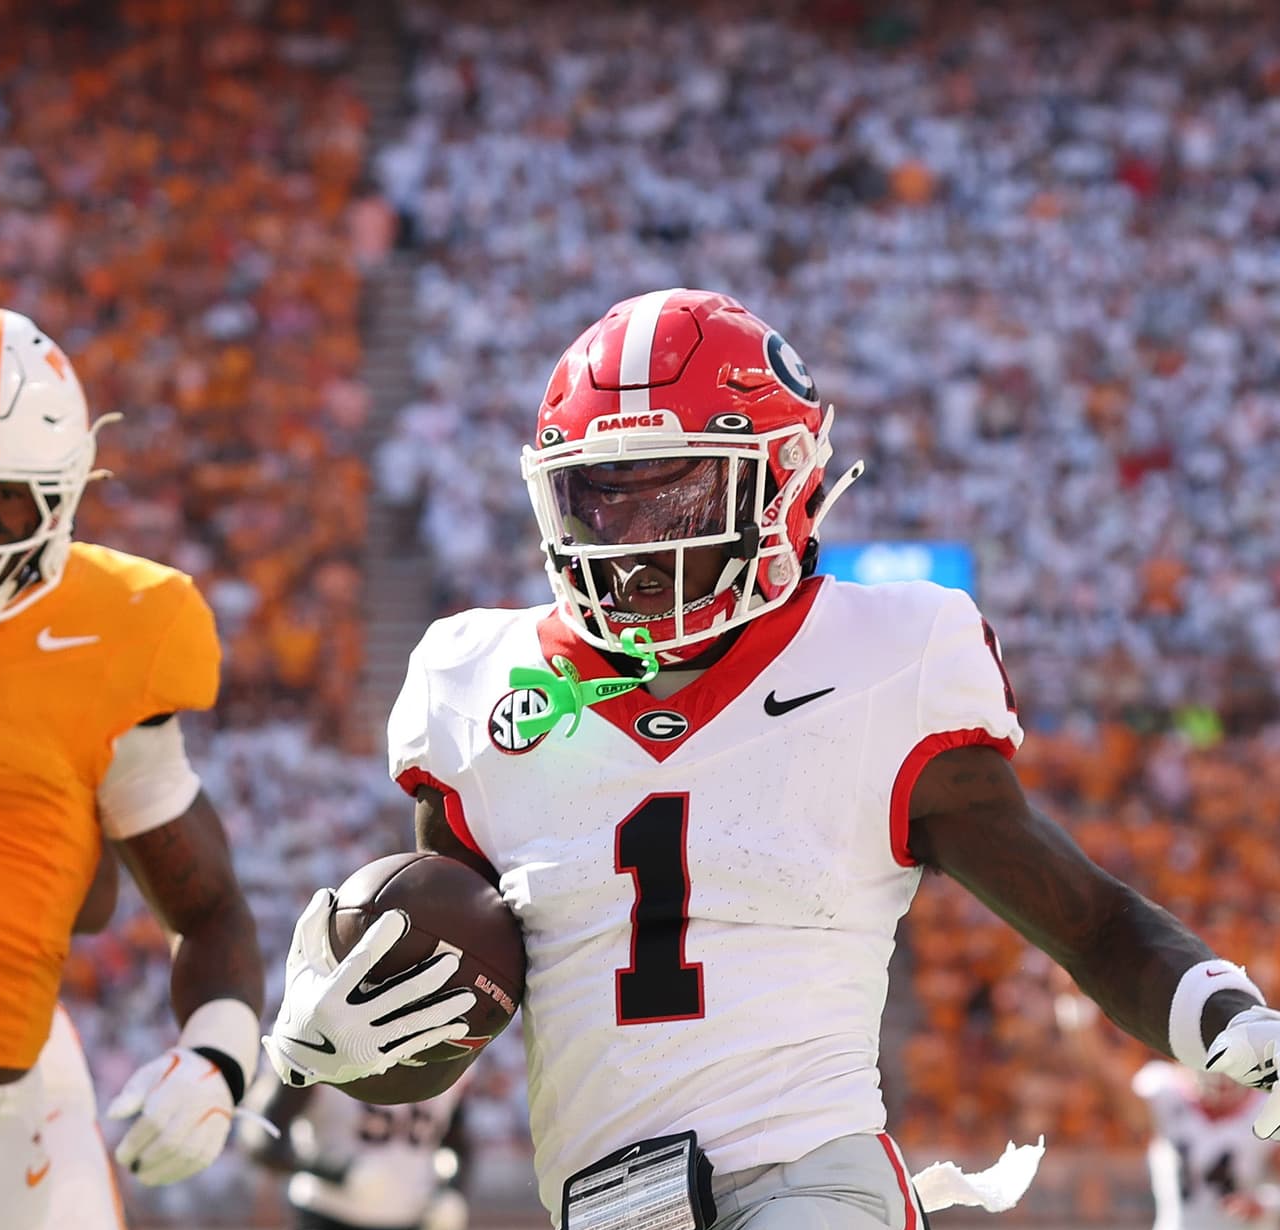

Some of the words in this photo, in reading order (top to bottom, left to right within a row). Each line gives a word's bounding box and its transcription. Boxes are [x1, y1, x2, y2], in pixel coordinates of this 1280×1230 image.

[597, 413, 665, 432] DAWGS
[635, 709, 689, 742] G
[614, 790, 706, 1027] 1
